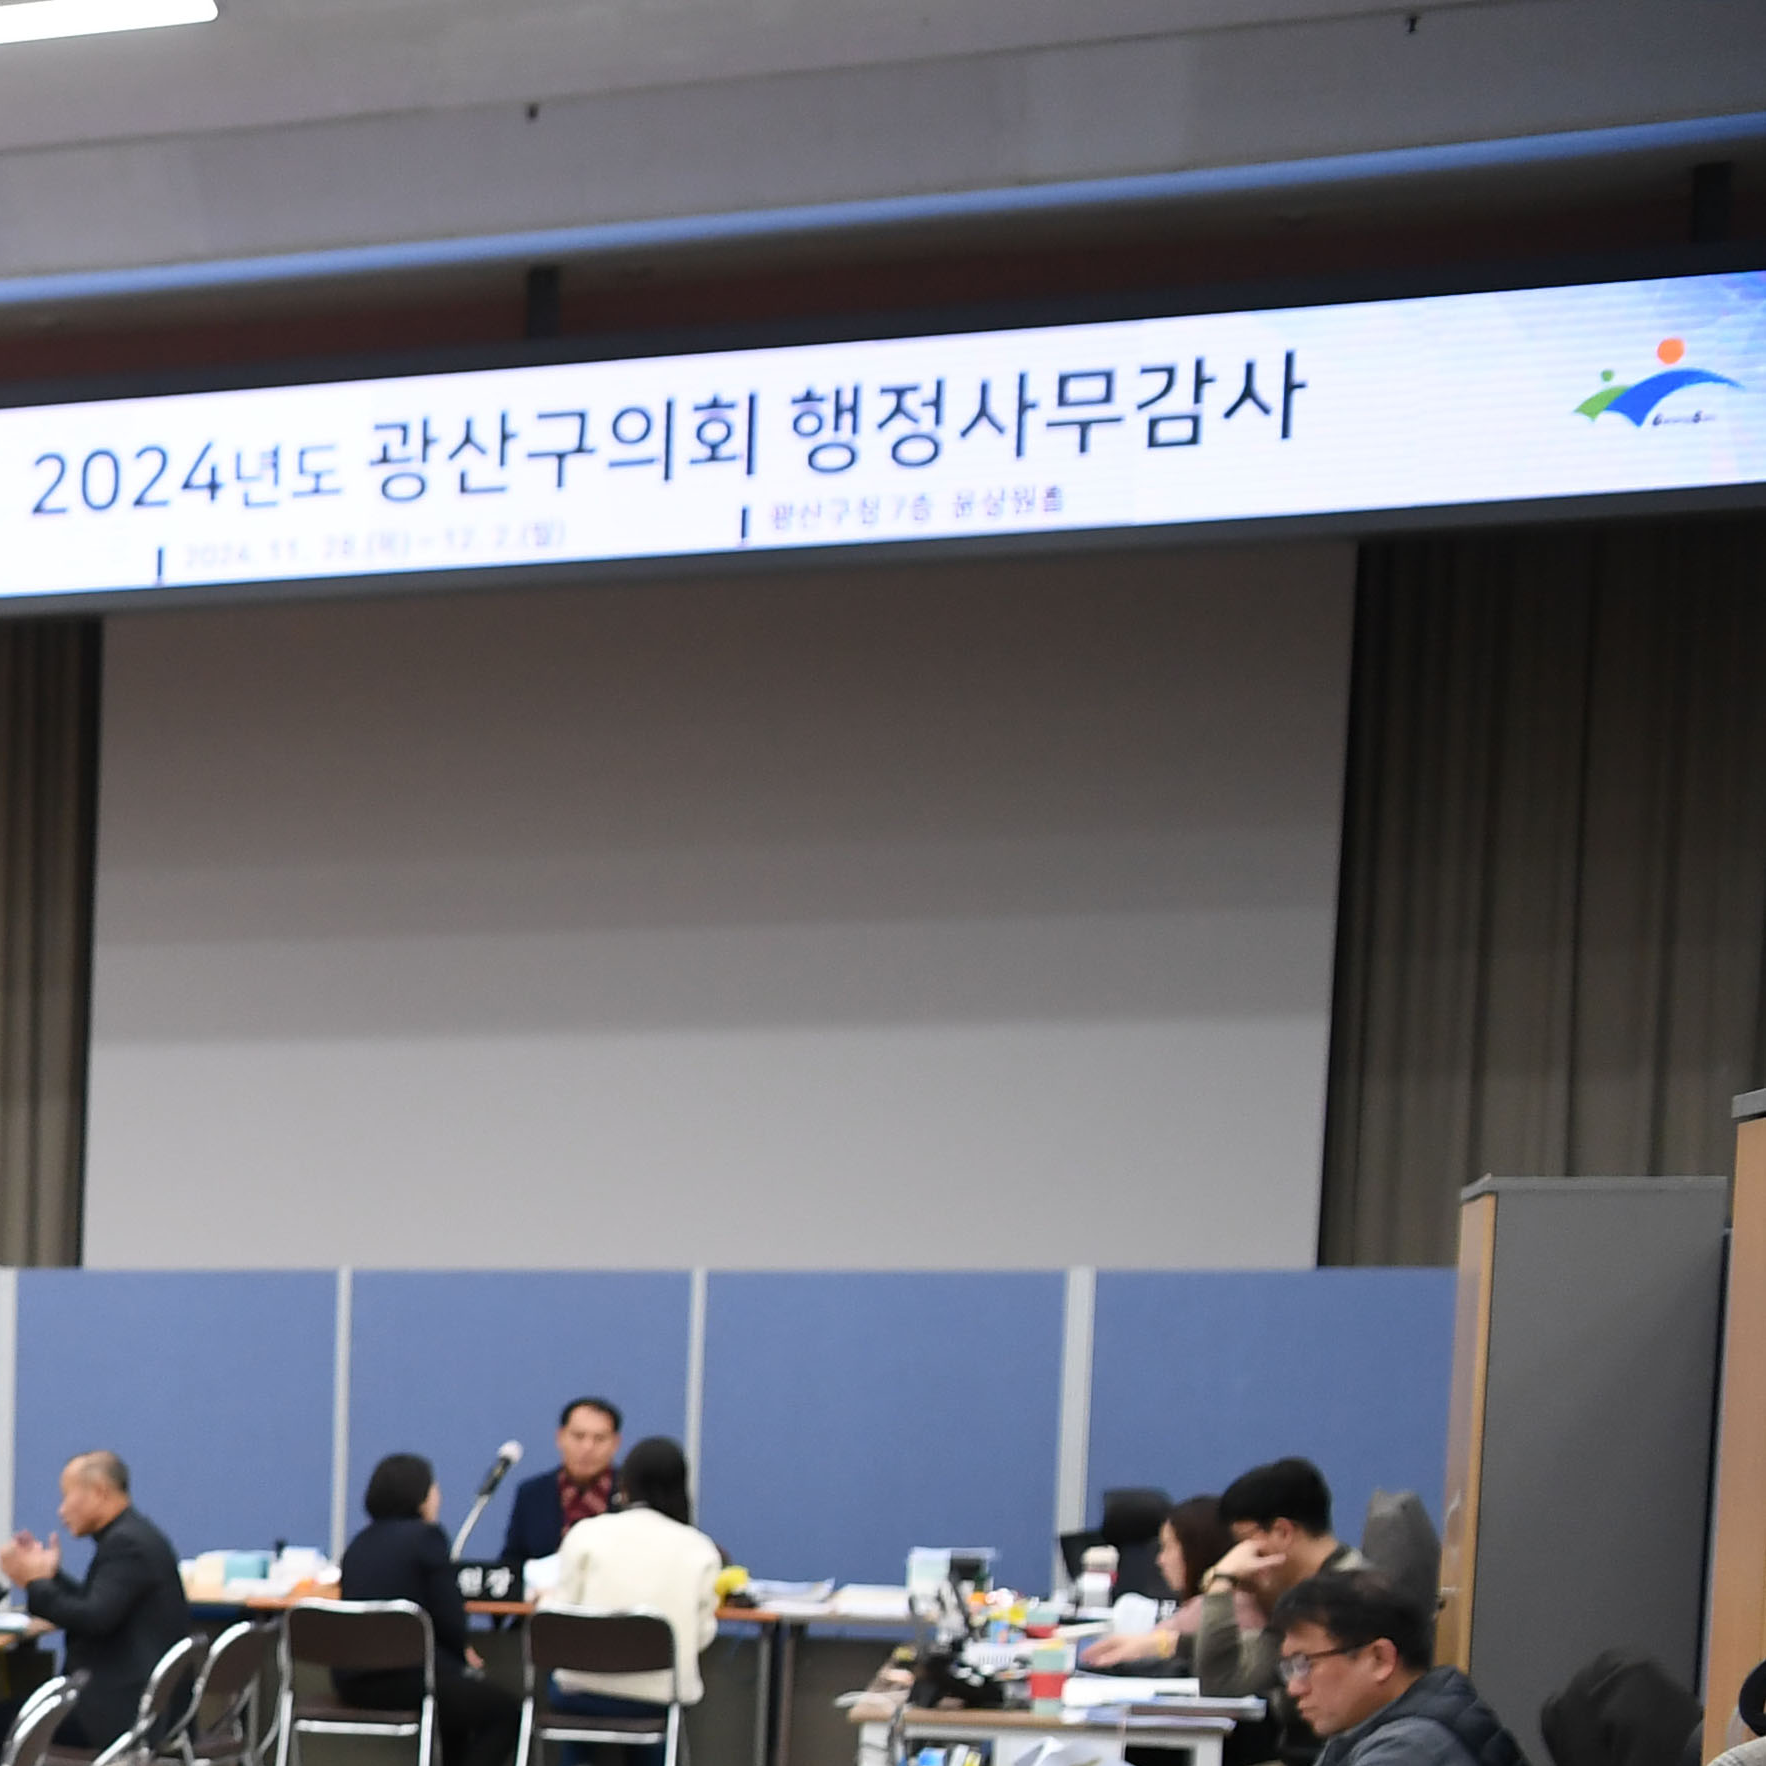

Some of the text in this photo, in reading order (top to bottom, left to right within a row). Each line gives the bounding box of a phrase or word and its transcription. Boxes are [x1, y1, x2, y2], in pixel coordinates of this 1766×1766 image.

[31, 348, 1308, 516] 2024년도 광산구의회 행정사무감사
